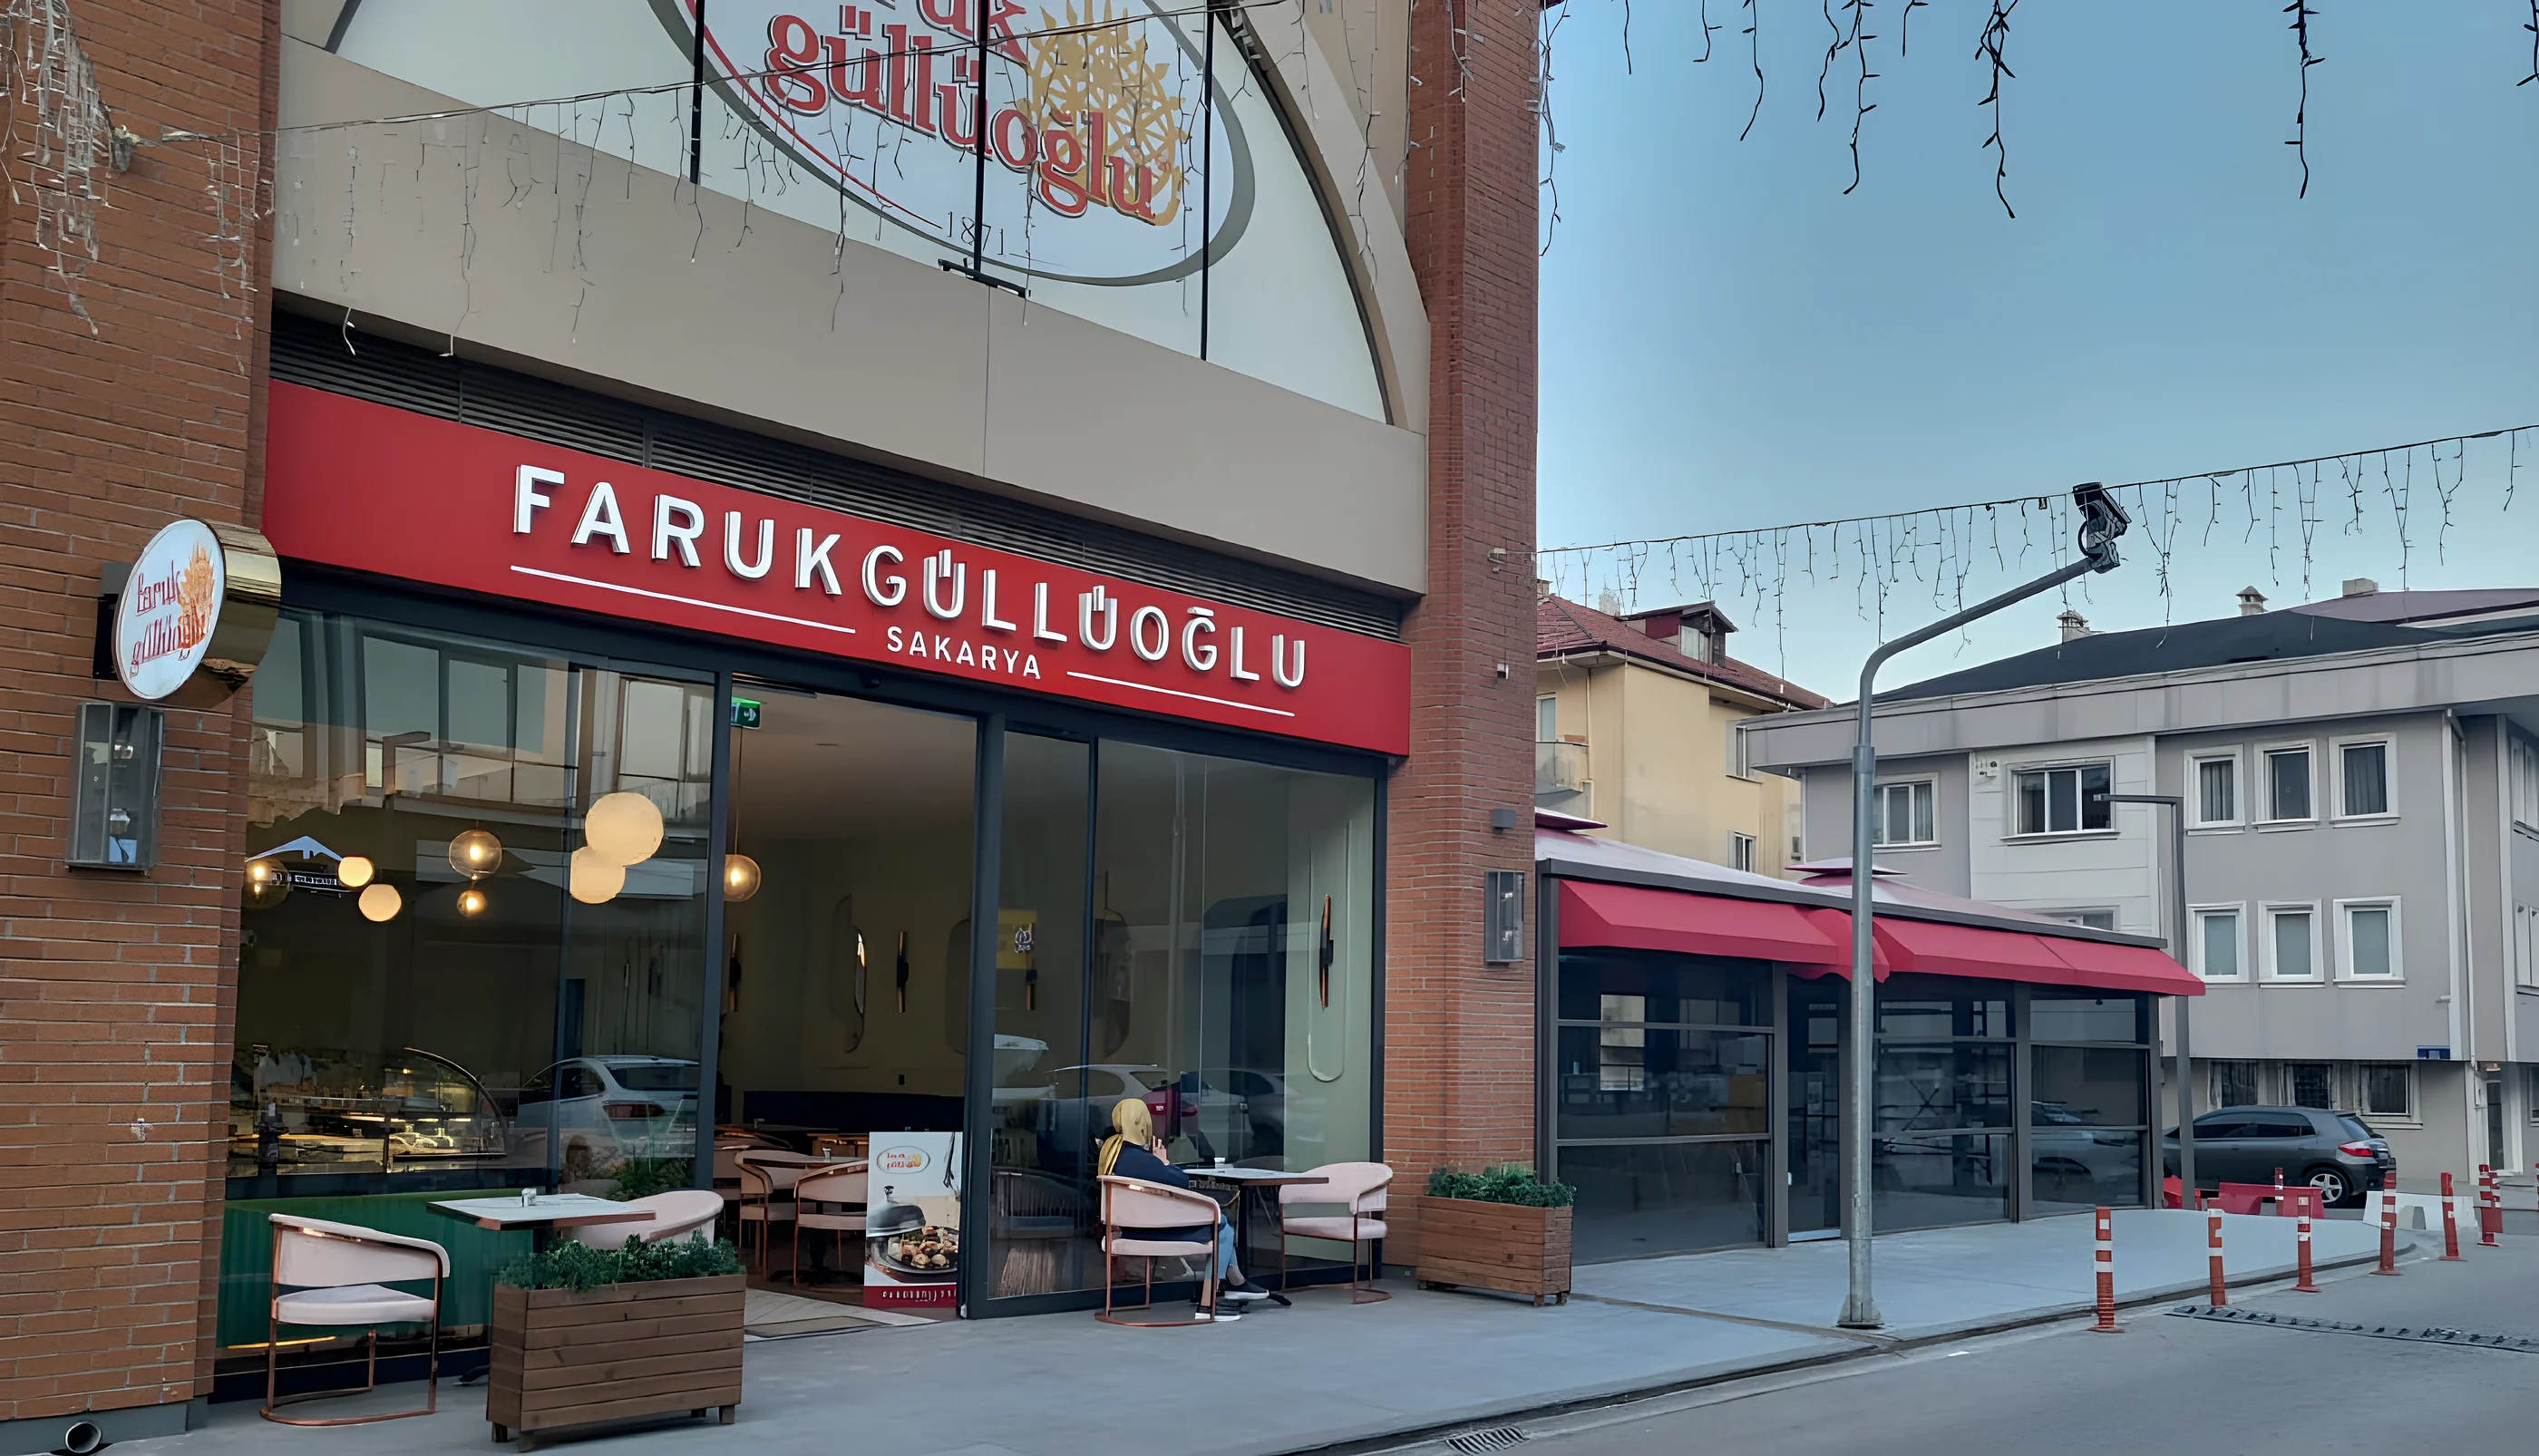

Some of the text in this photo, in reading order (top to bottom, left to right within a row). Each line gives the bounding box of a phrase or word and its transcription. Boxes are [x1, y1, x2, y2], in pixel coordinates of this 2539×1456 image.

[764, 5, 1157, 226] güllüoğlu
[947, 211, 1004, 256] 1871
[886, 625, 1043, 680] SAKARYA
